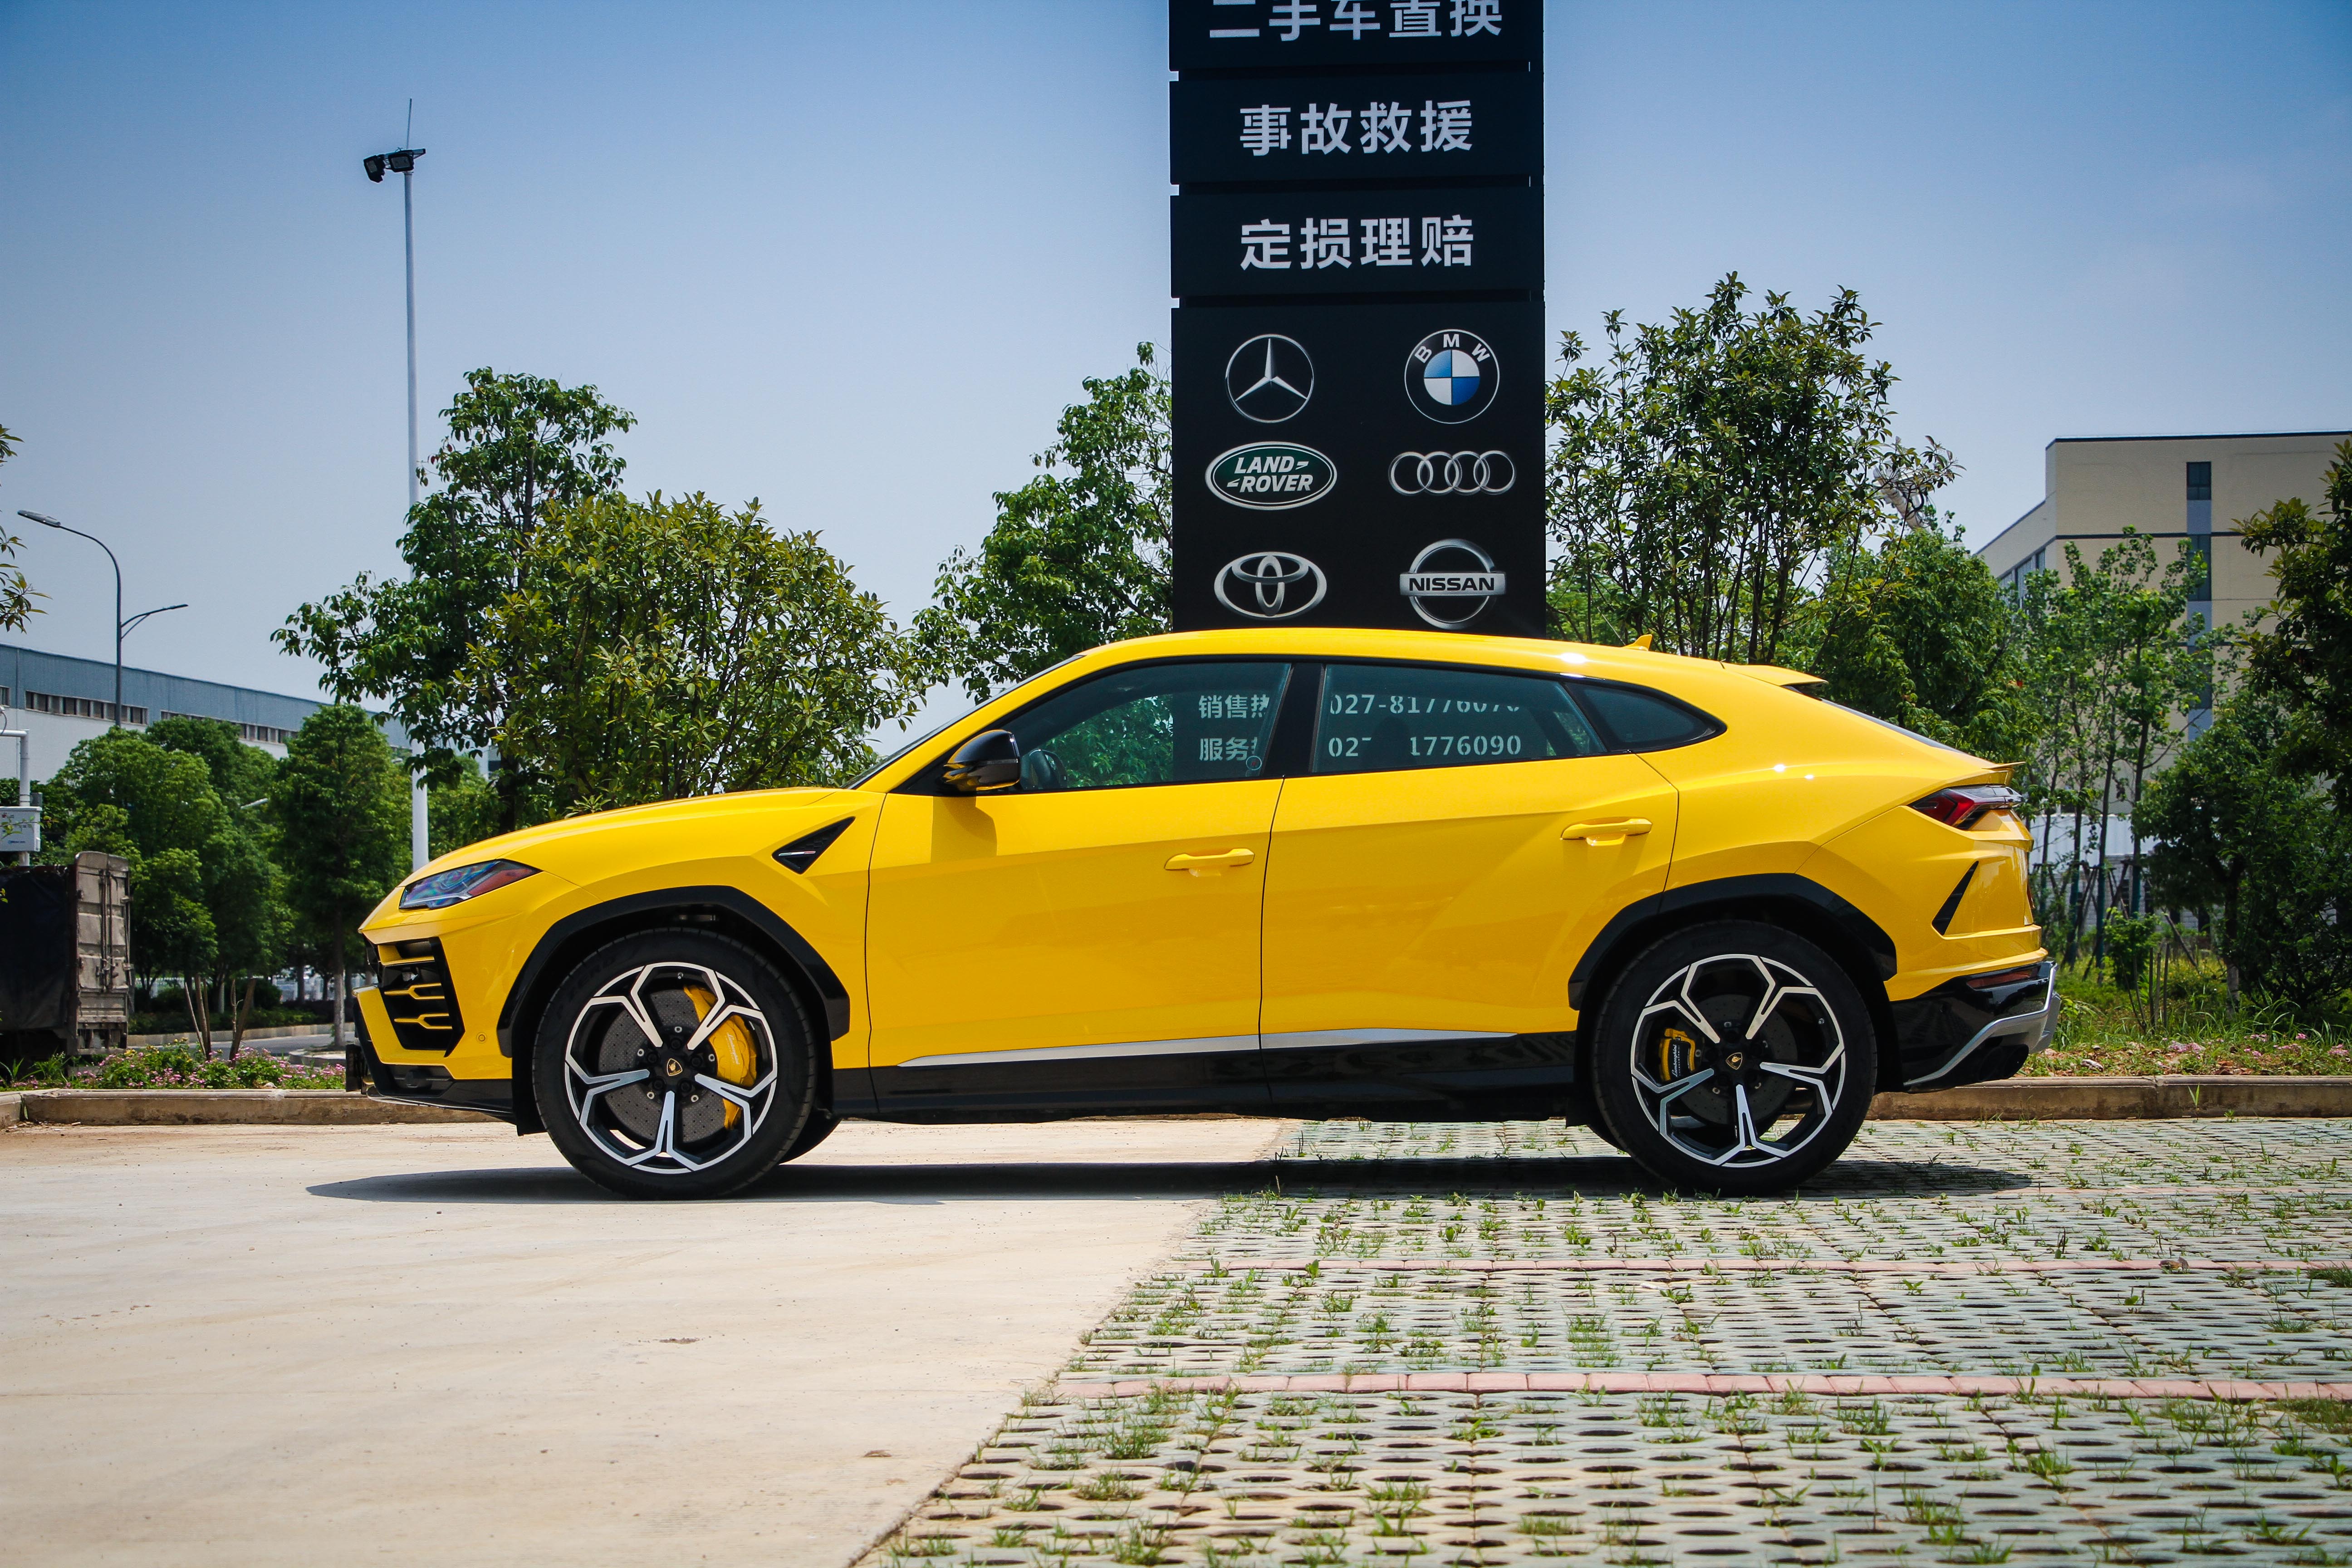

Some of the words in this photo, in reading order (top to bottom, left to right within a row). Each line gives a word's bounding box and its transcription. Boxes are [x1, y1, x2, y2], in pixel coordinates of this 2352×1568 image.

[1210, 0, 1503, 41] 二手车置换
[1240, 100, 1473, 156] 事故救援
[1240, 215, 1474, 270] 定损理赔
[1414, 333, 1490, 363] BMW
[1234, 456, 1295, 474] LAND
[1239, 475, 1313, 493] ROVER
[1409, 578, 1494, 591] NISSAN
